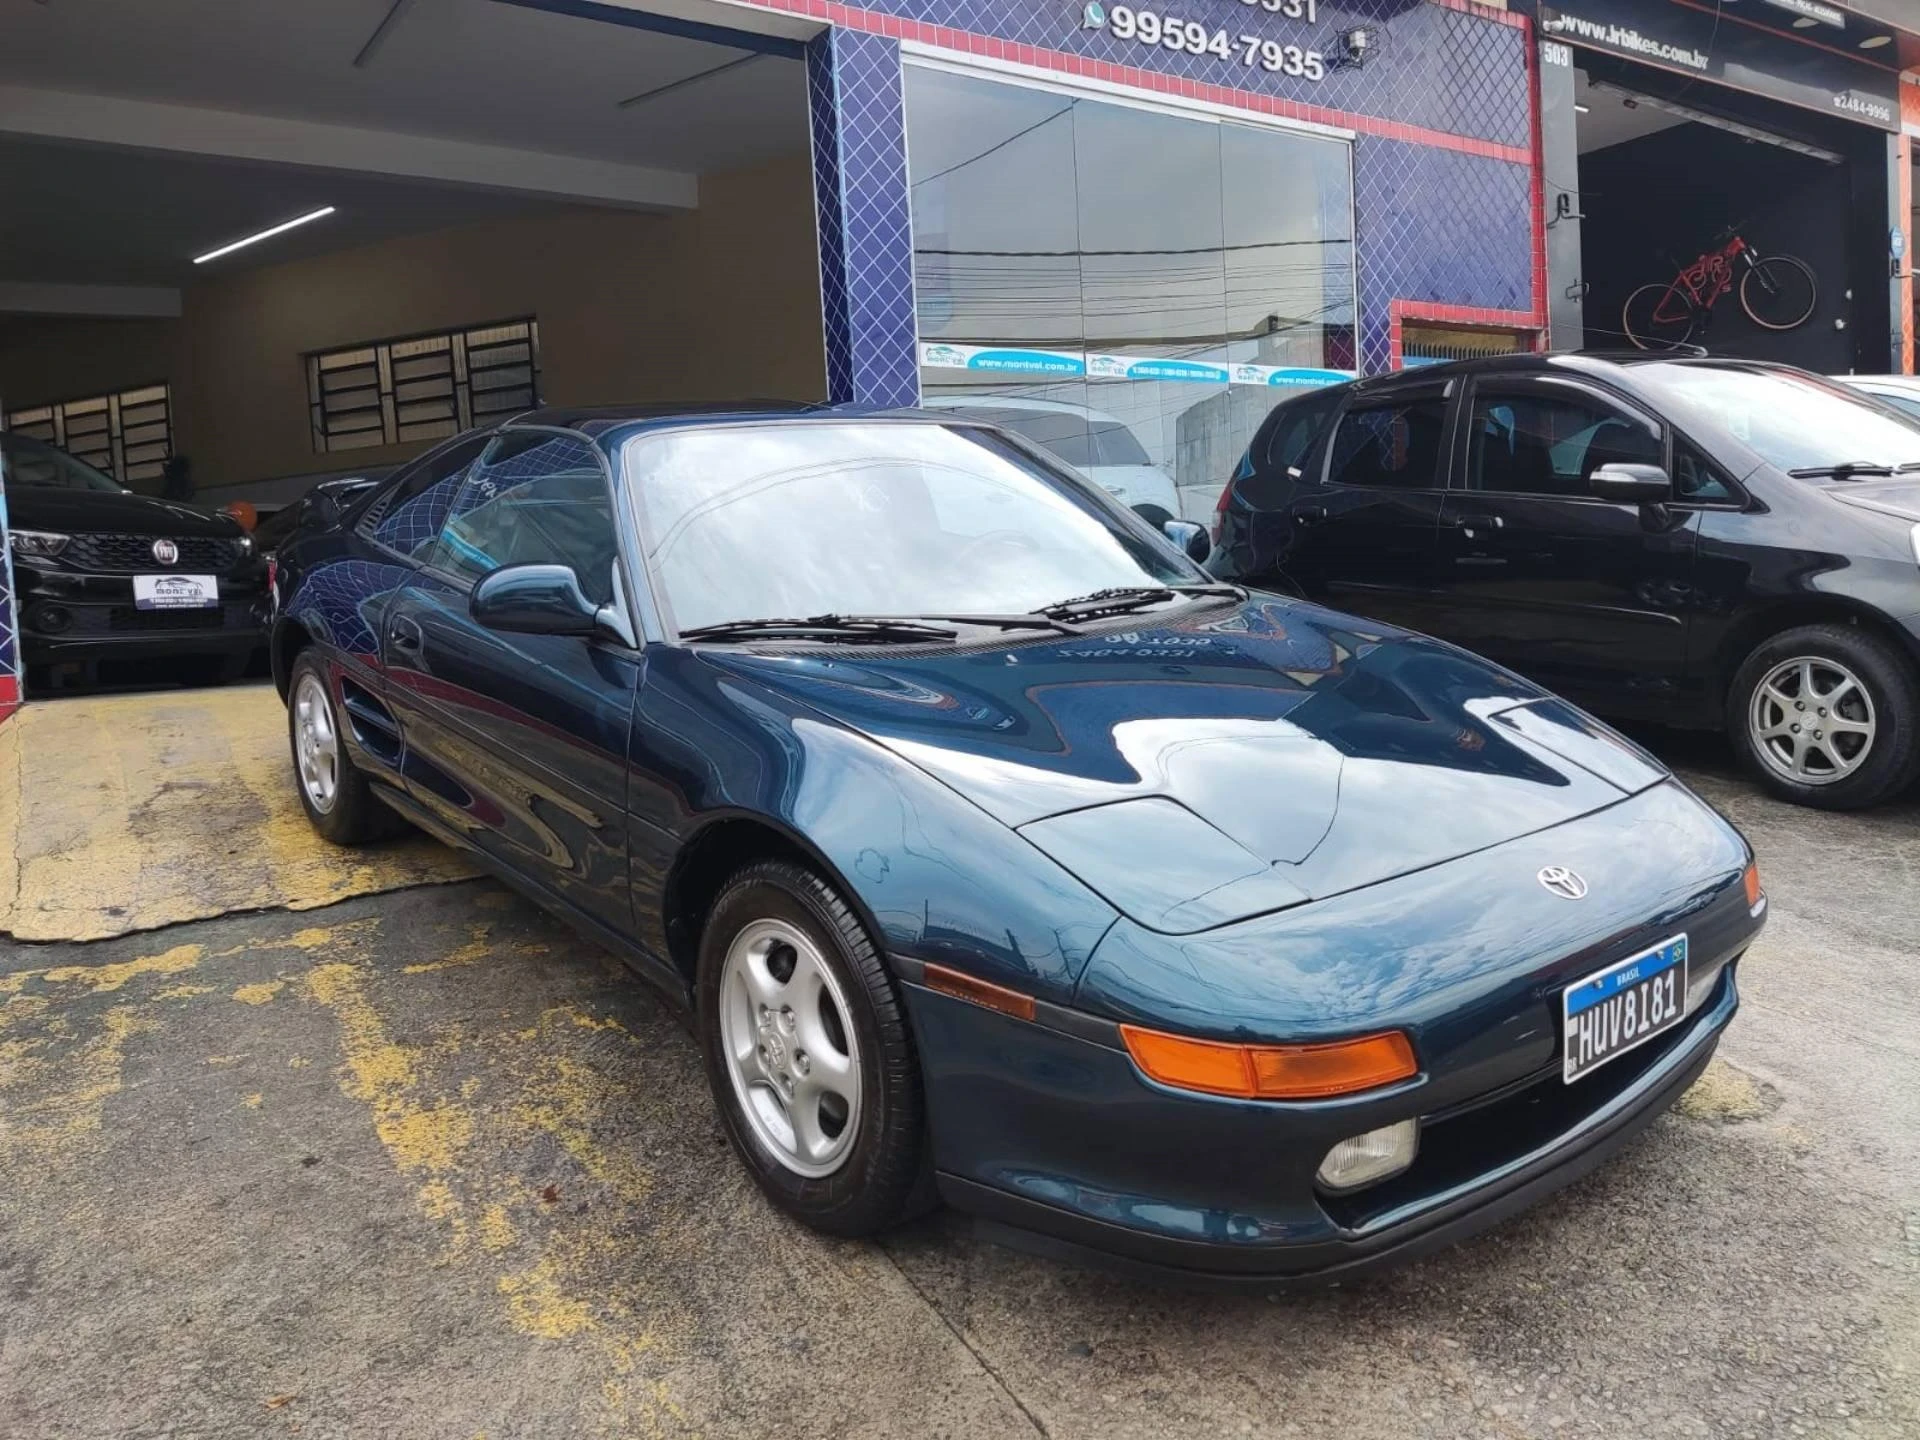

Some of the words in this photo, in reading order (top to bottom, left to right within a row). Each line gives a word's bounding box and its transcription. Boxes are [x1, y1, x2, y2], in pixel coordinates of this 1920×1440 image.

[1110, 5, 1325, 81] 99594-7935
[1544, 42, 1568, 67] 503
[1616, 967, 1640, 986] BRASIL
[1579, 968, 1677, 1066] HUV8I81
